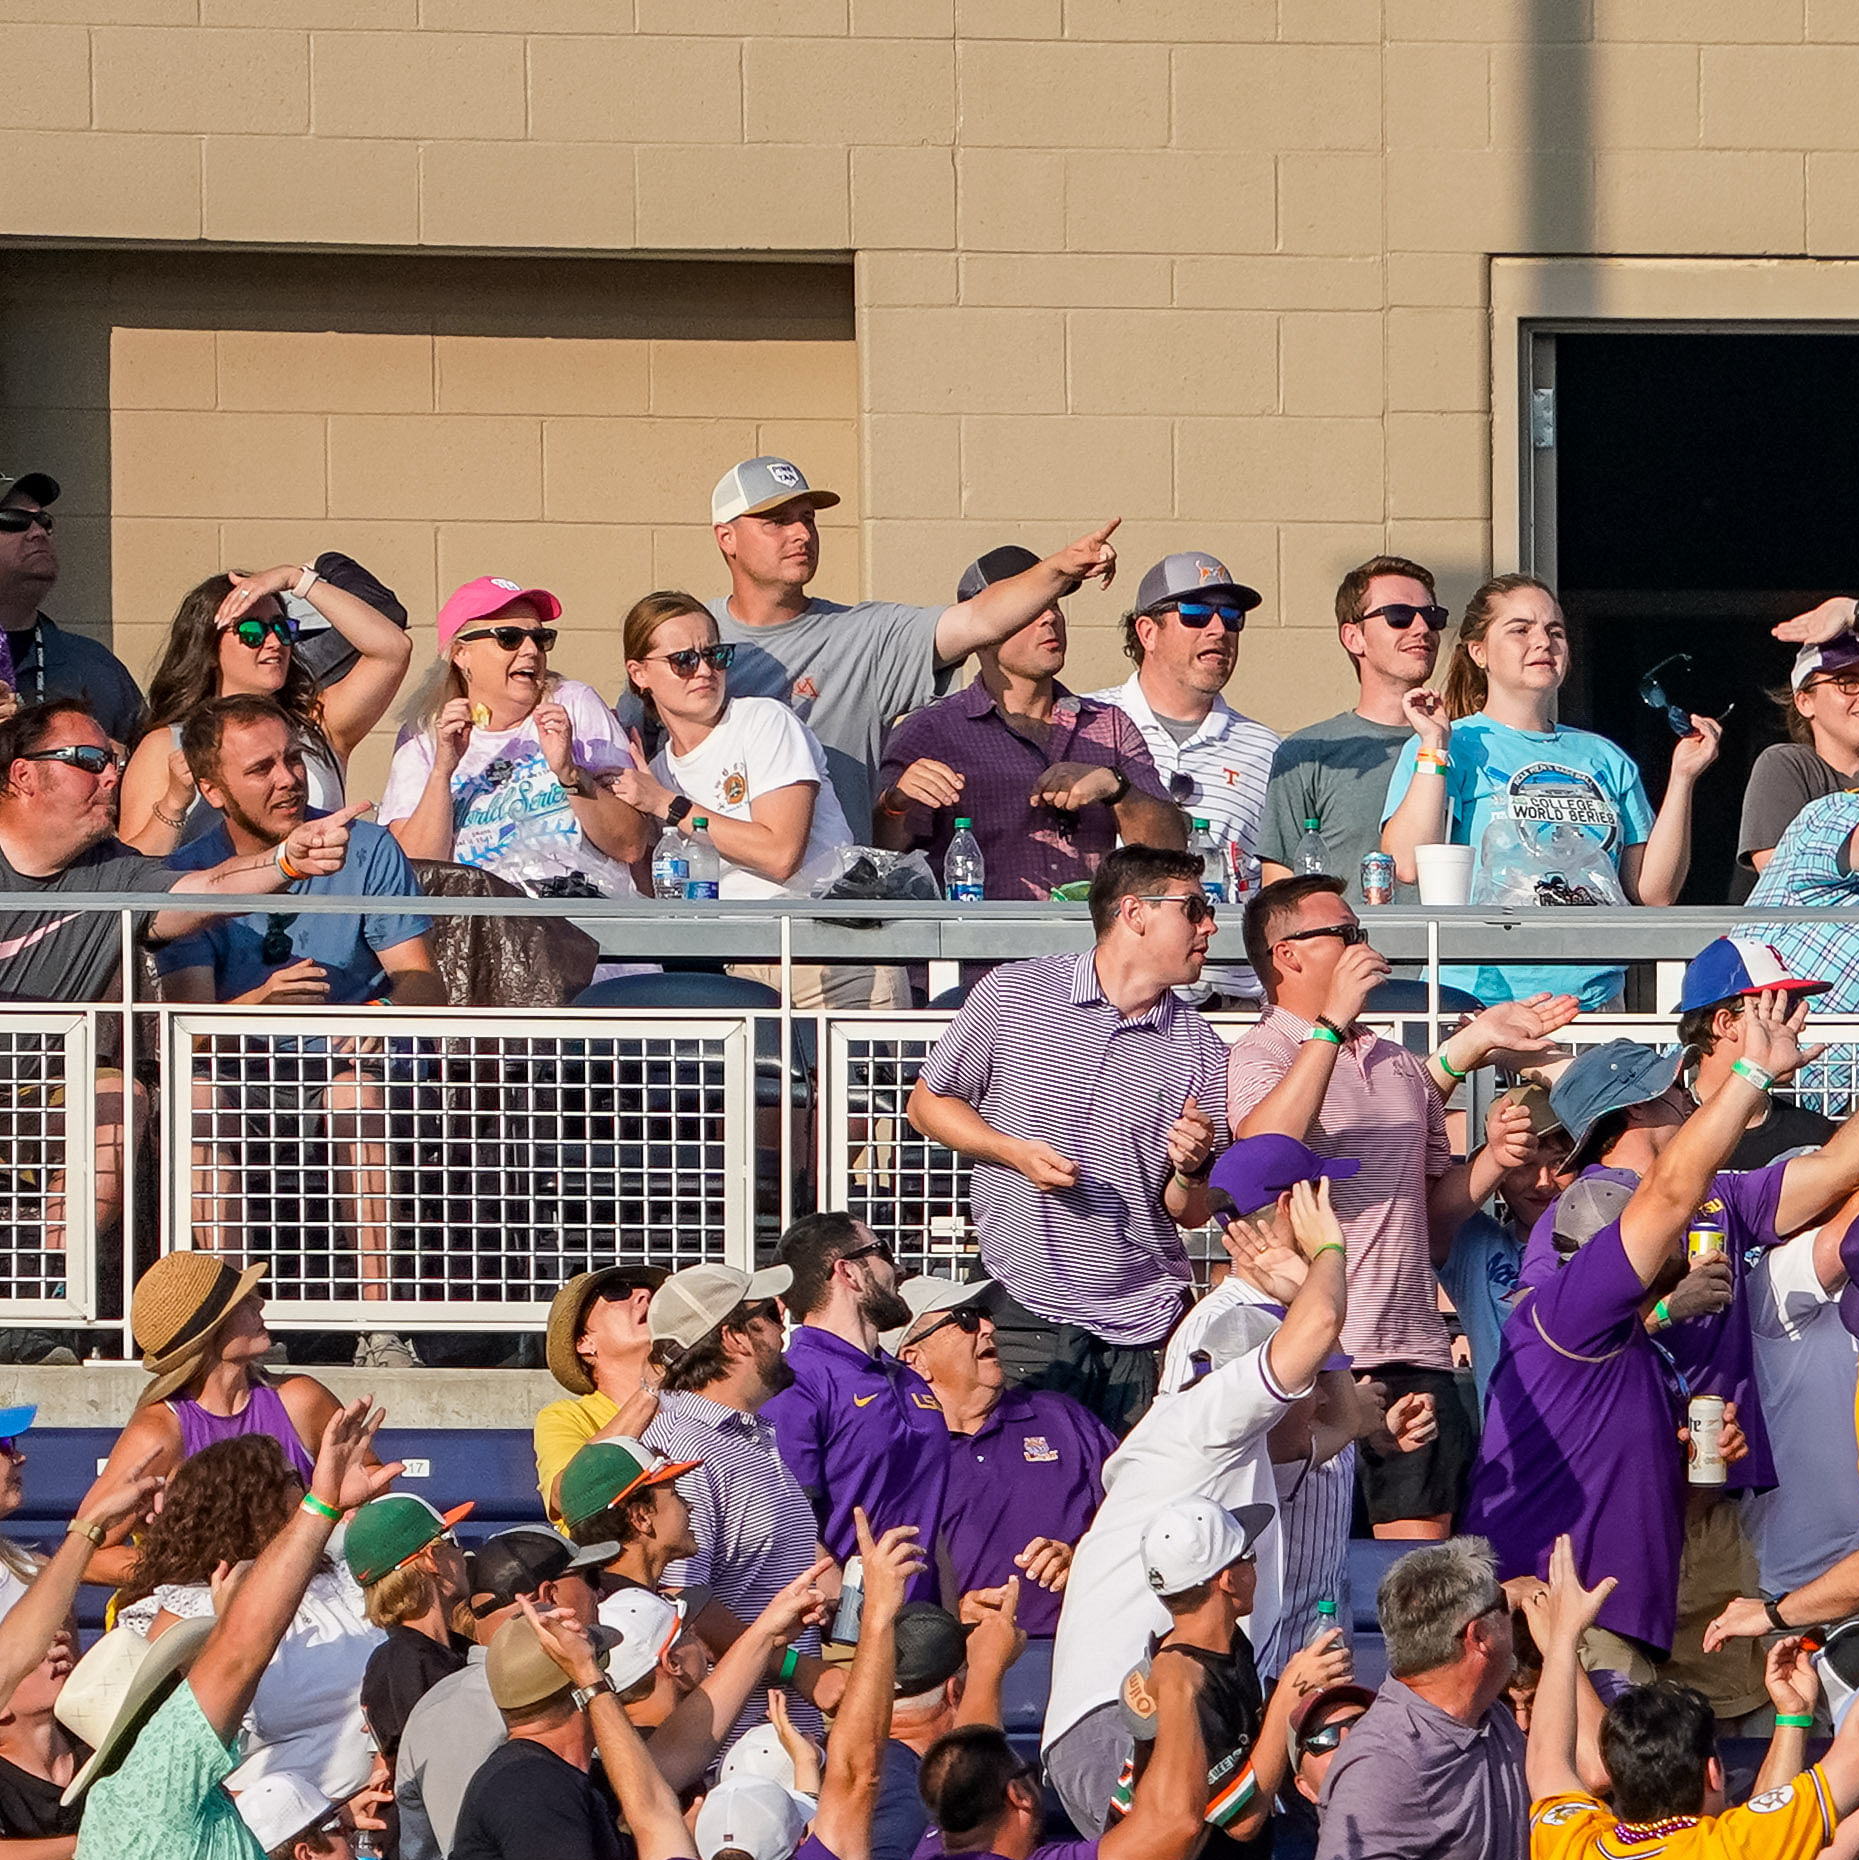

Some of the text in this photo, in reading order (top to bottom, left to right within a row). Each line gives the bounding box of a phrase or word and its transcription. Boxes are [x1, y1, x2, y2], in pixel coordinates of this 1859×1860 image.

[1223, 767, 1241, 786] T
[1513, 805, 1617, 825] WORLD SERIES
[1529, 798, 1598, 813] COLLEGE
